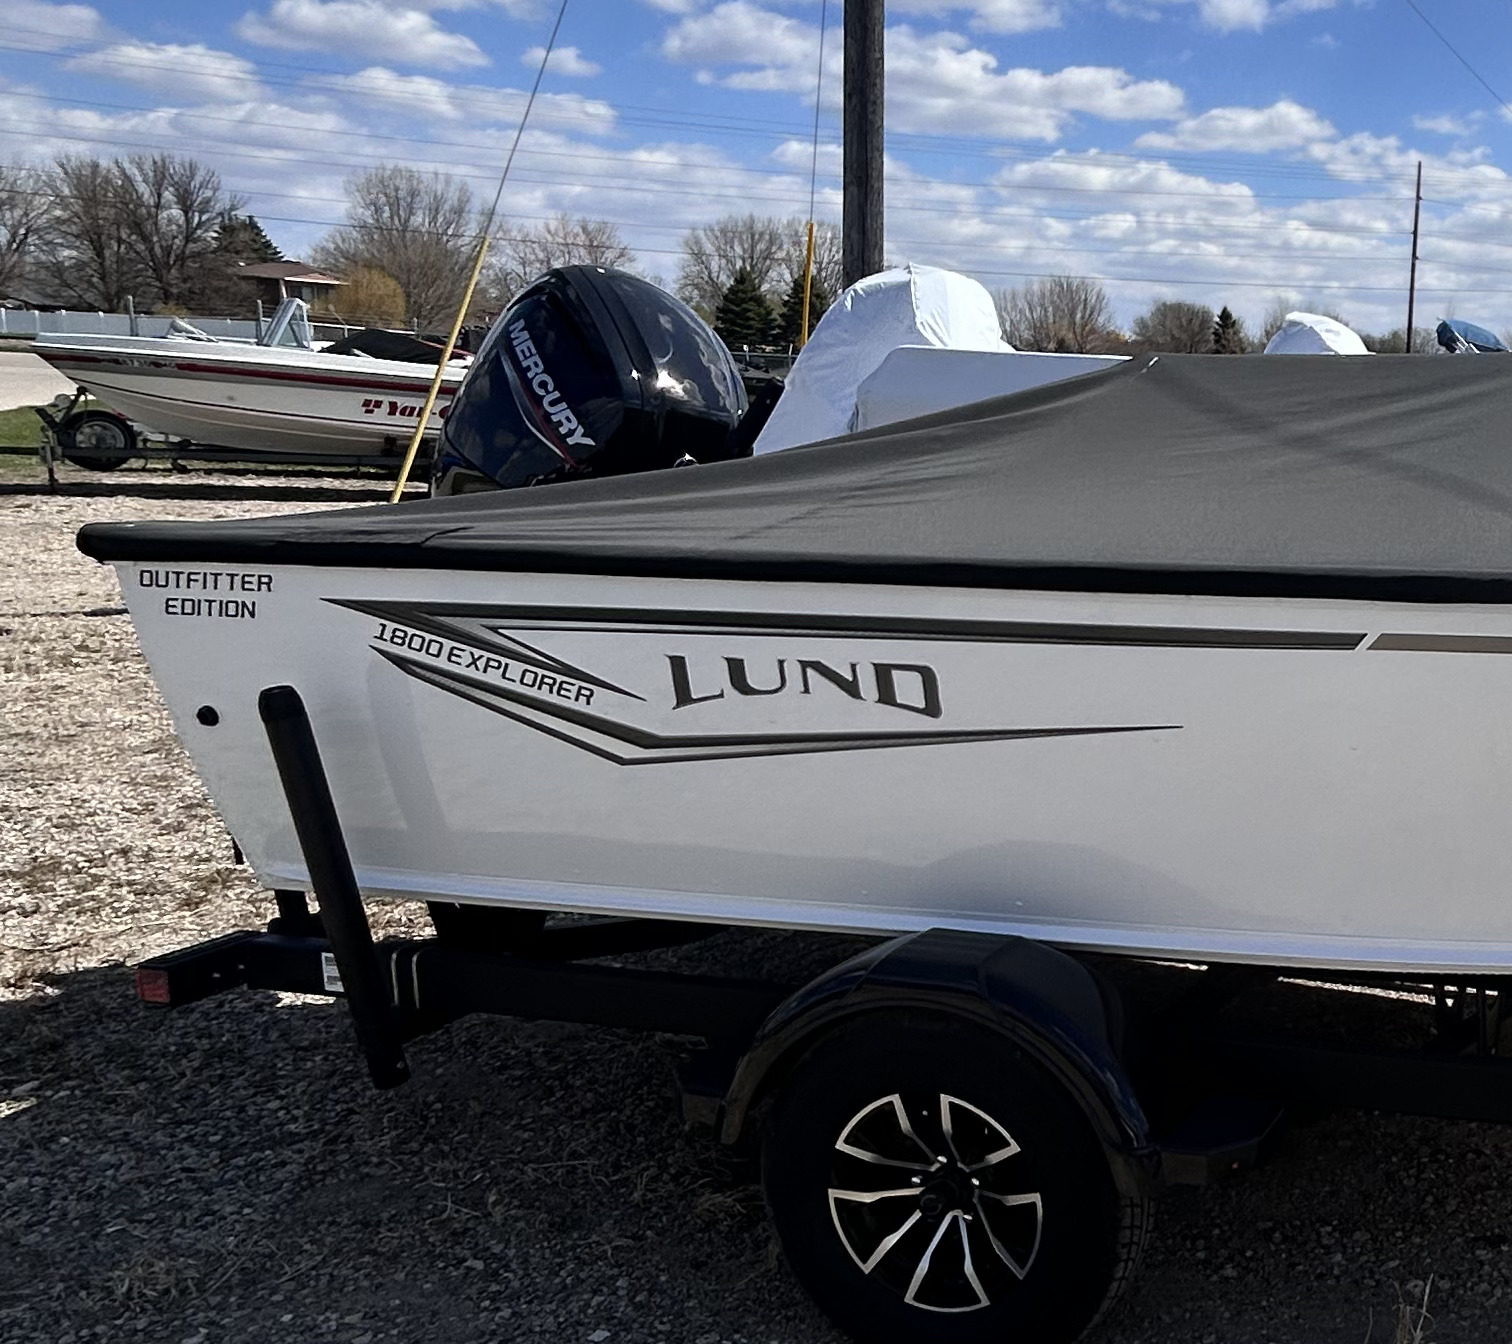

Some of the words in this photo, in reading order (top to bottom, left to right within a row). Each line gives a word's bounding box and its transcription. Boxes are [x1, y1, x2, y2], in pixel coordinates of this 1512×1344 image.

[509, 318, 596, 447] MERCURY
[139, 569, 273, 592] OUTFITTER
[164, 597, 256, 619] EDITION
[373, 622, 444, 659] 1800
[447, 646, 595, 706] EXPLORER
[664, 653, 943, 719] LUND
